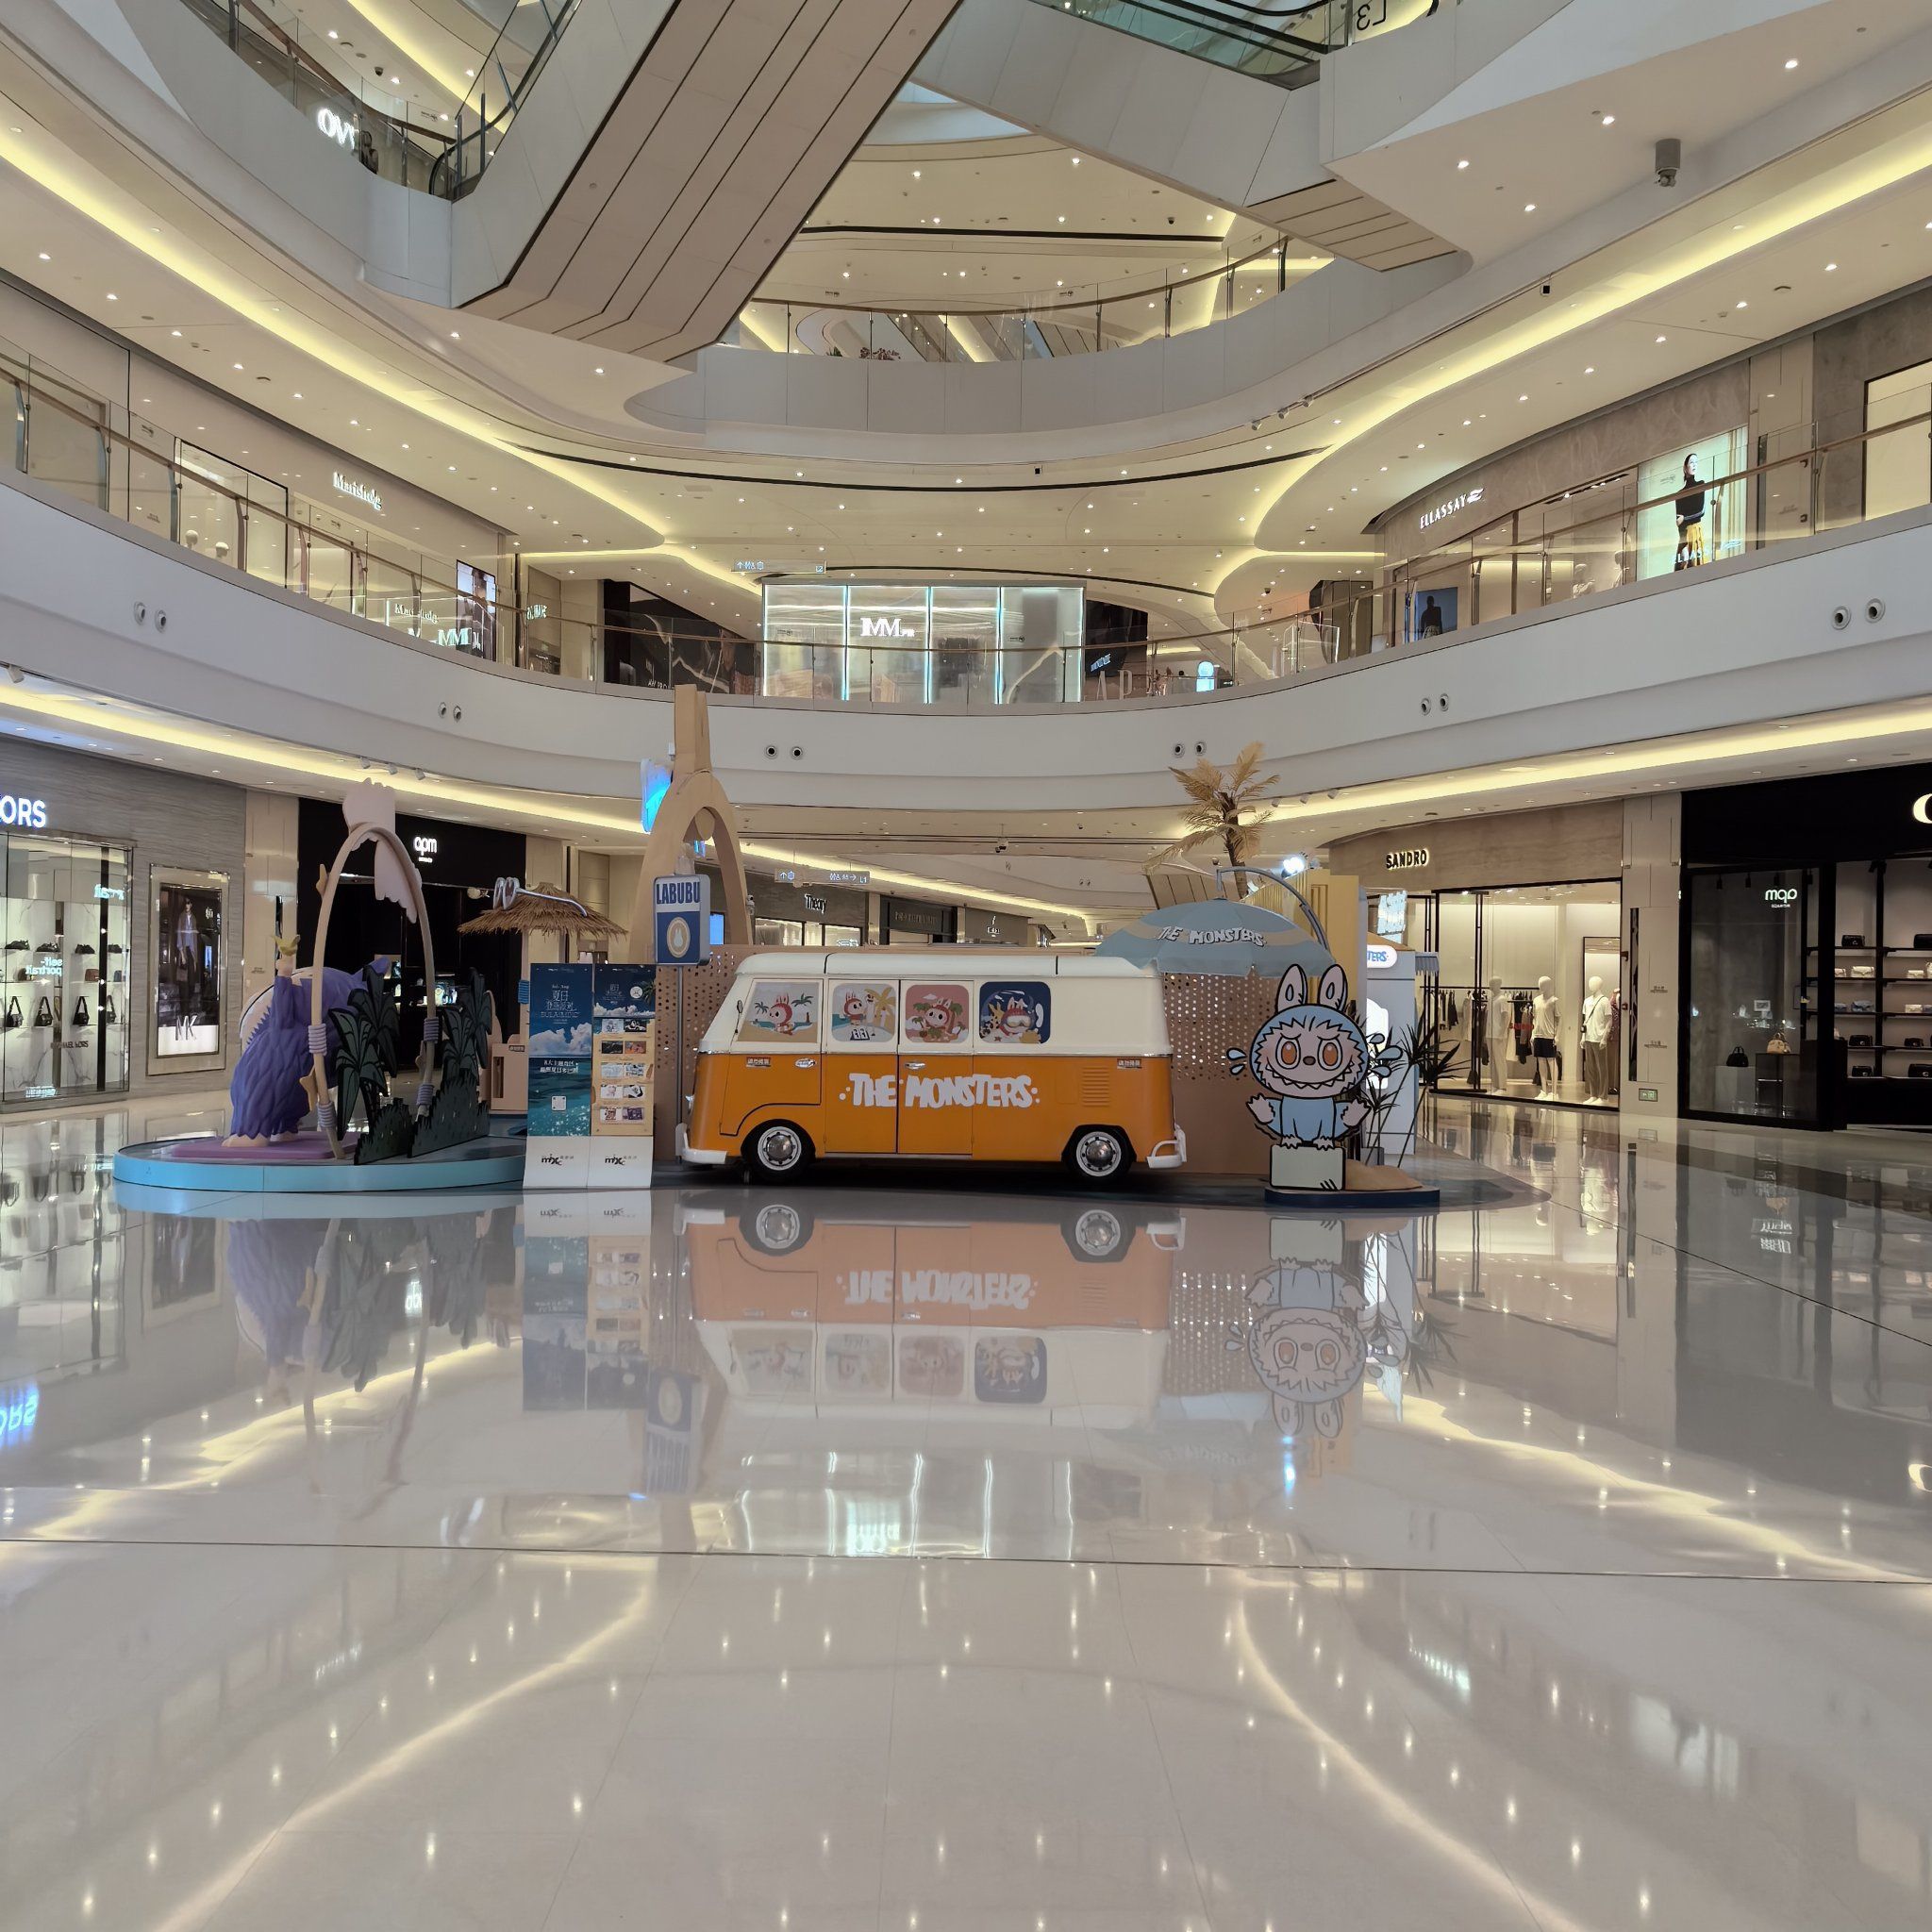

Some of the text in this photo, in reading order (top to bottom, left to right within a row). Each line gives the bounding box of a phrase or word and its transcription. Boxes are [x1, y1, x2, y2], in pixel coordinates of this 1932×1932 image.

[1419, 493, 1468, 529] ELLASSAY
[1385, 848, 1429, 870] SANDRO
[656, 881, 701, 905] LABUBU
[804, 893, 828, 915] Theory
[1188, 926, 1265, 947] MONSTERS
[175, 1014, 198, 1041] MK
[849, 1073, 1033, 1108] THE MONSTERS
